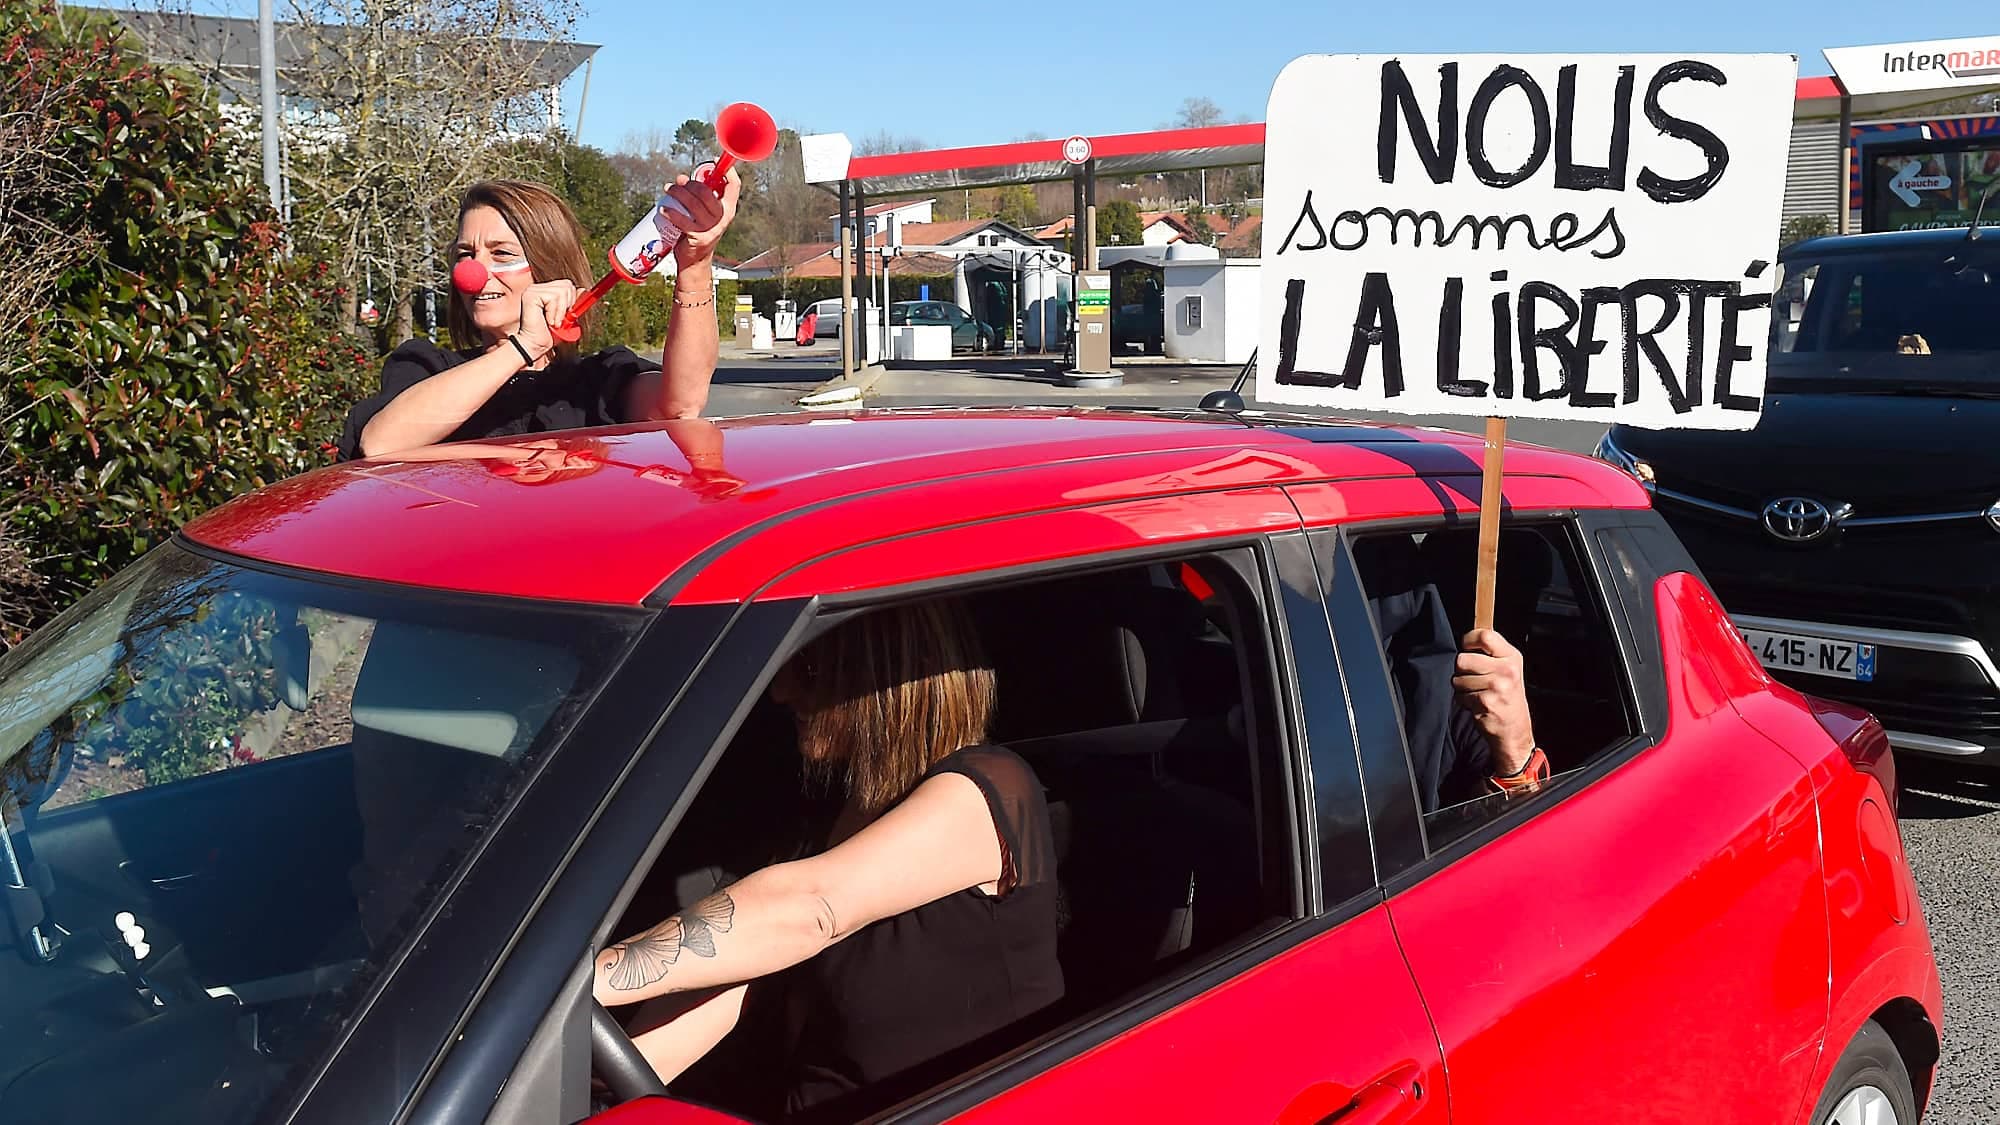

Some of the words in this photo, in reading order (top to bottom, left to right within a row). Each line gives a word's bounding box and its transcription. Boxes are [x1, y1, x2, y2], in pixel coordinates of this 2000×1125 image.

[1377, 58, 1730, 204] NOUS
[1904, 178, 1940, 189] gauche
[1276, 189, 1626, 259] sommes
[1275, 272, 1405, 398] LA
[1856, 663, 1872, 676] 64
